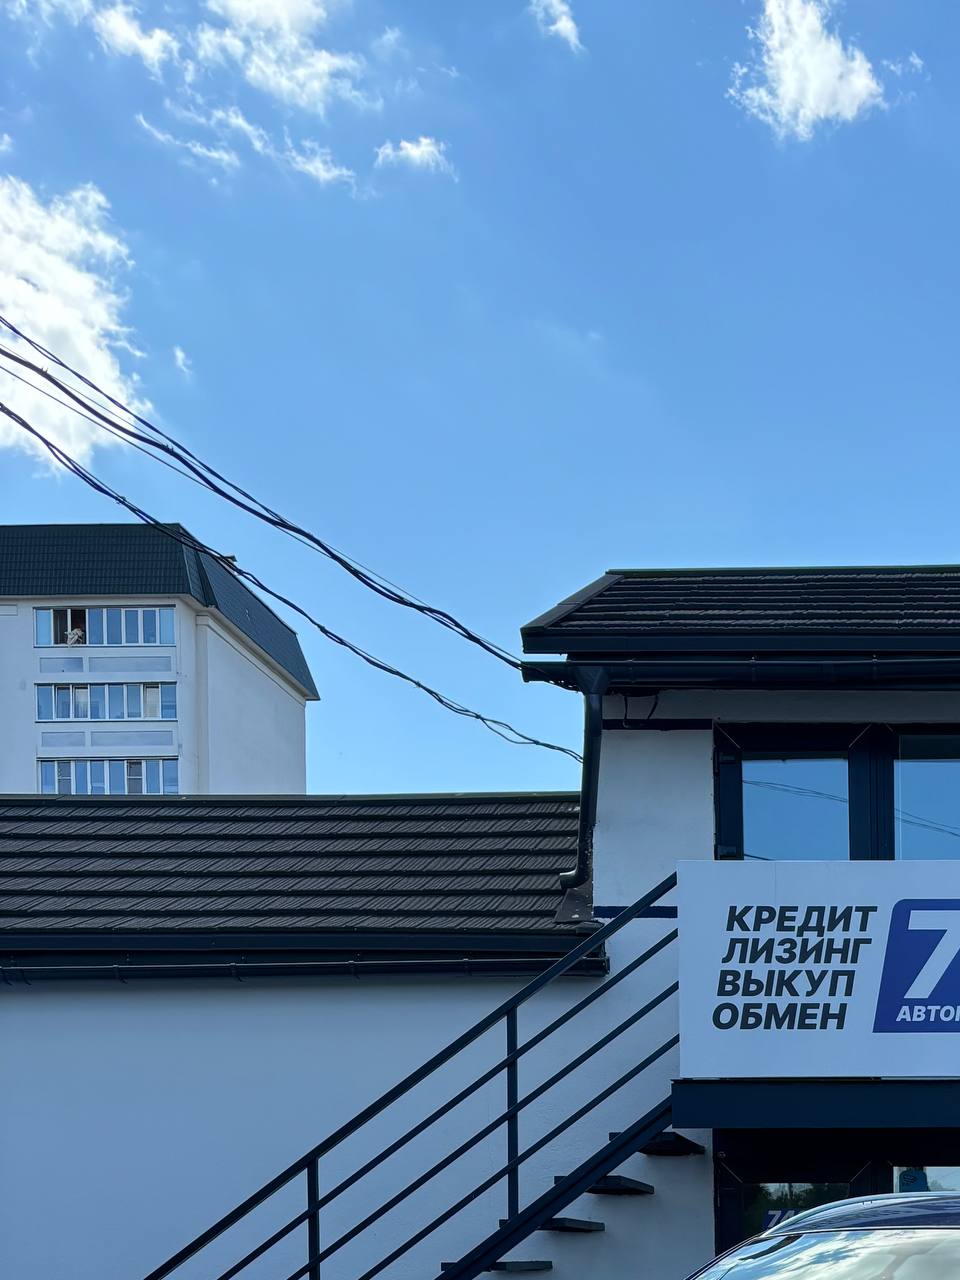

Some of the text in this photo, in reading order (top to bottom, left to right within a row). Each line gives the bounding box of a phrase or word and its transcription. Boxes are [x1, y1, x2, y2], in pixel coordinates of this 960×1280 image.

[726, 905, 878, 937] КРЕДИТ
[721, 938, 872, 964] ЛИЗИНГ
[716, 969, 856, 997] ВЫКУП
[712, 1002, 848, 1030] ОБМЕН
